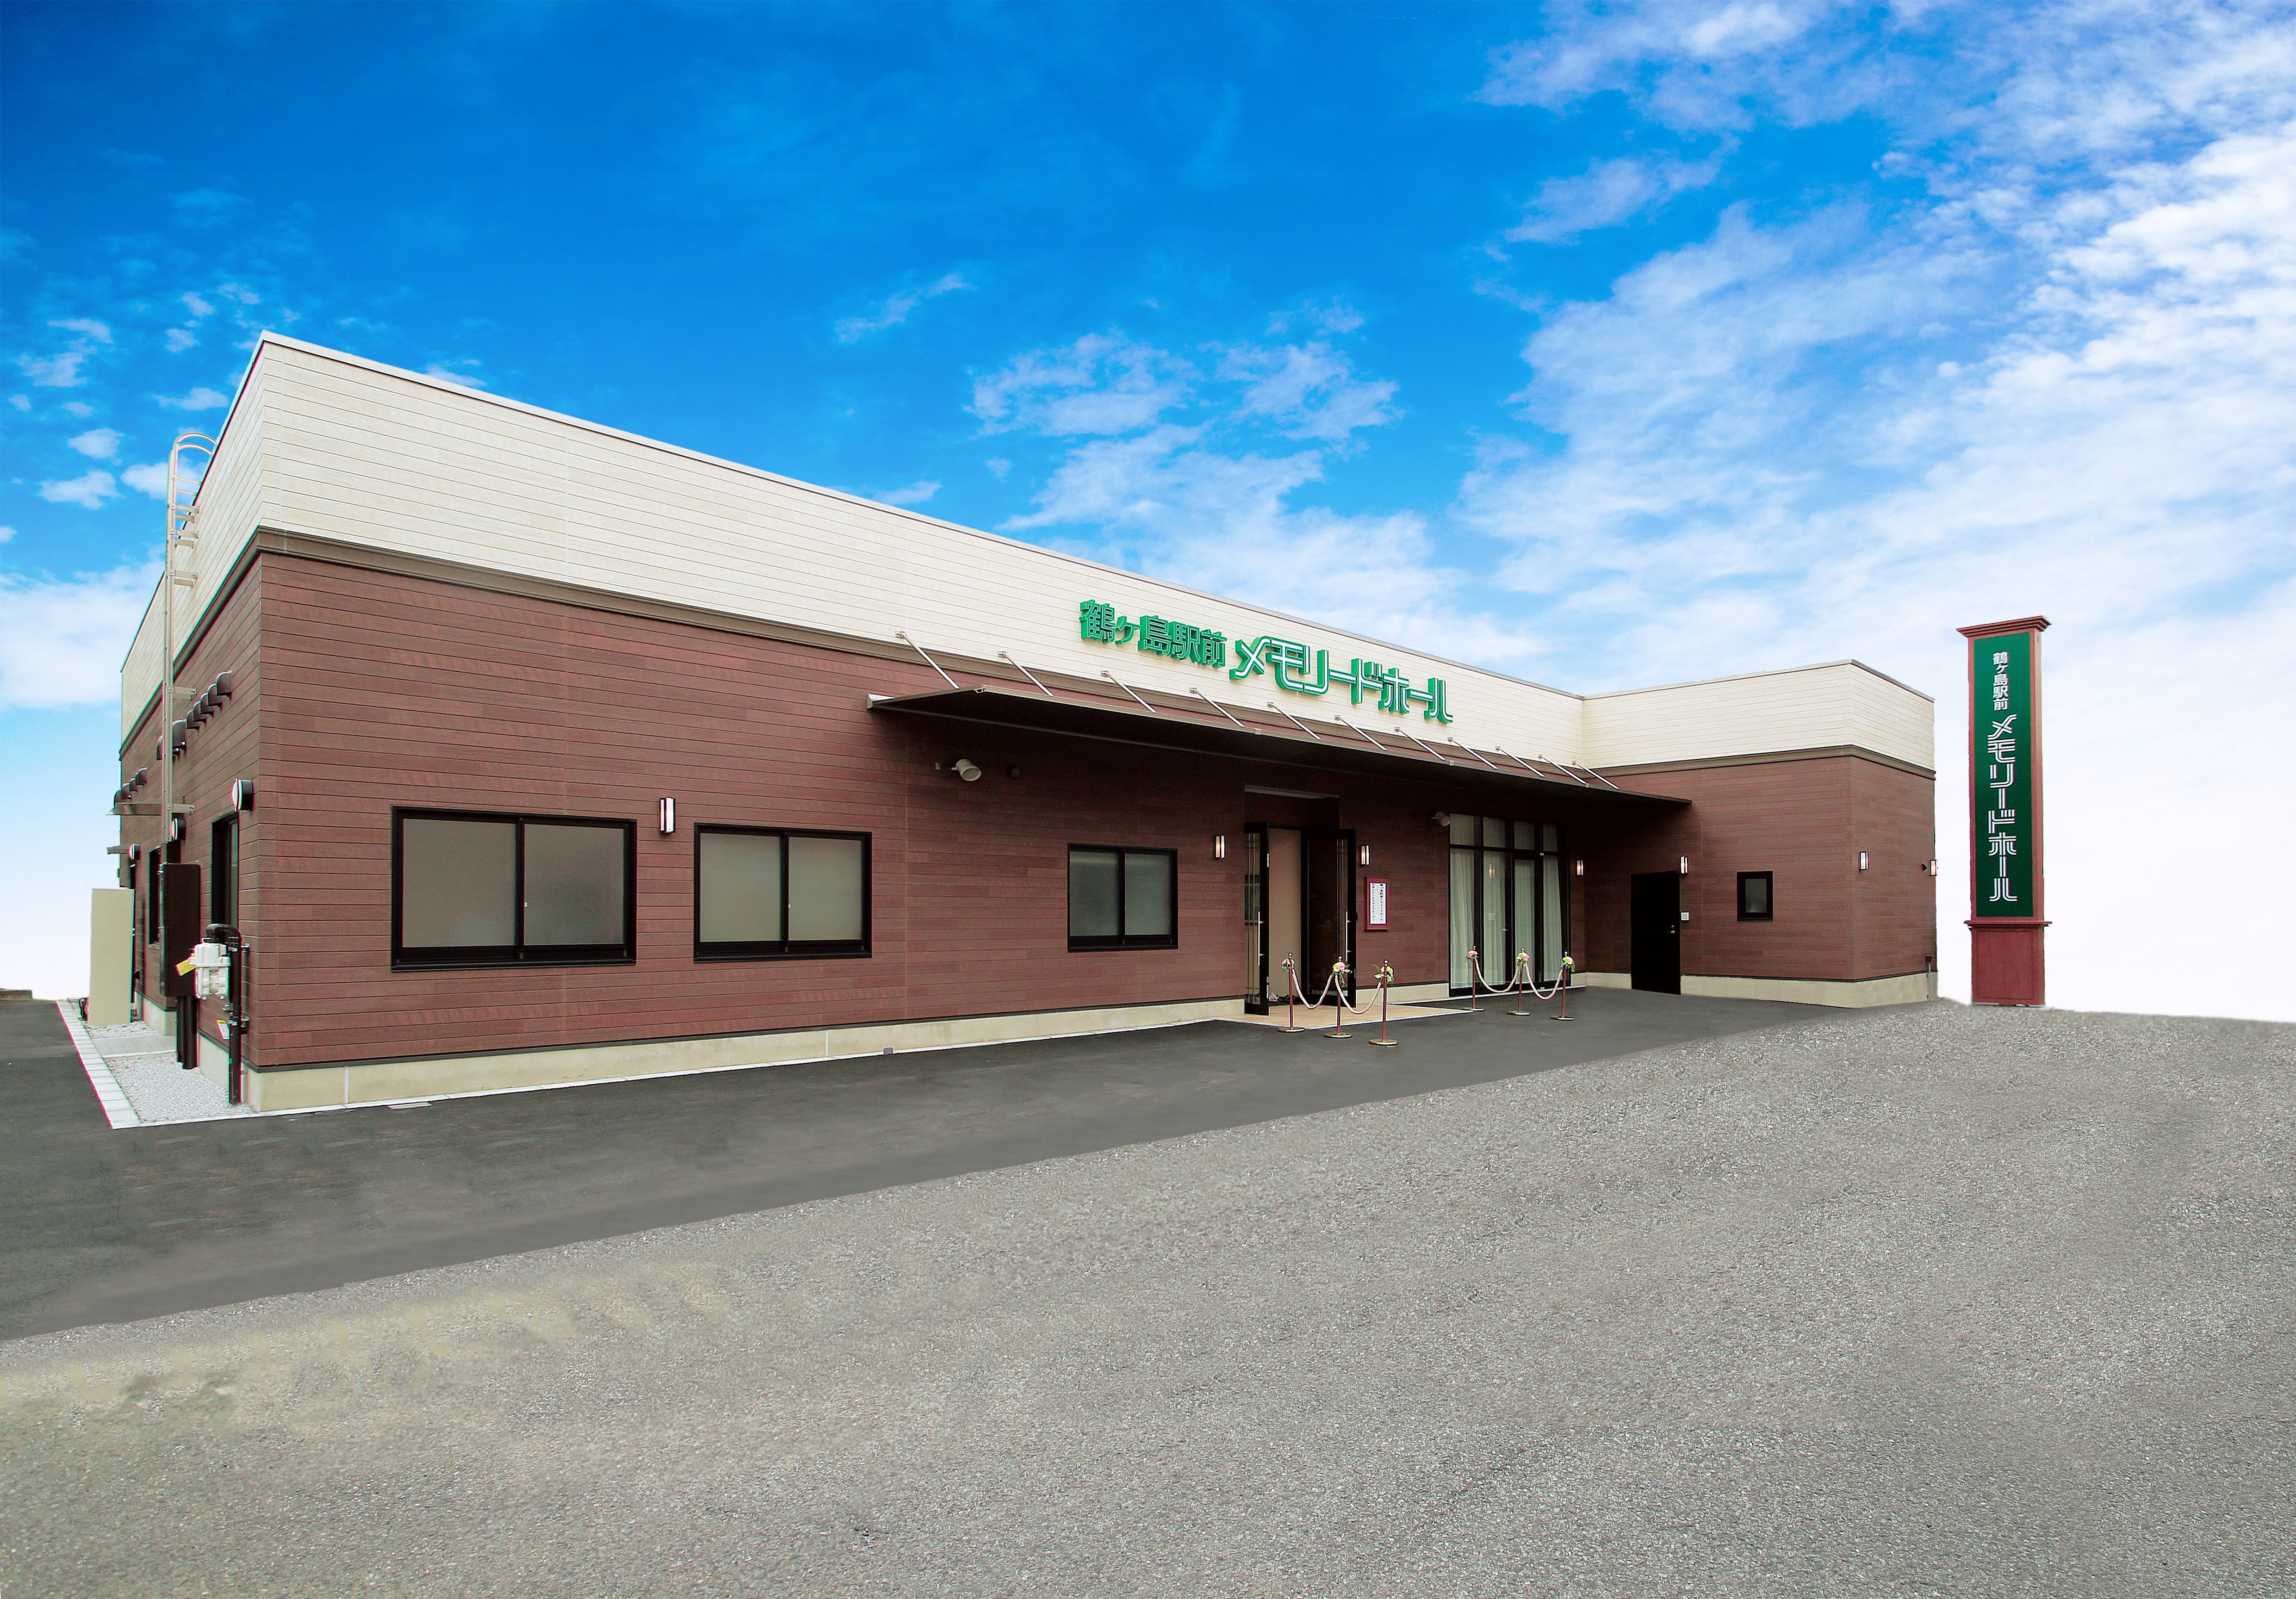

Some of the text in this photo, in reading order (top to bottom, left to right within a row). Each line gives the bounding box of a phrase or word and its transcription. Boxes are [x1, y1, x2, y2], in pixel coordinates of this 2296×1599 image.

[1080, 600, 1453, 723] 鶴ヶ島駅前 メモリードホール
[1987, 651, 2017, 902] 鶴ヶ島駅前 メモリードホール
